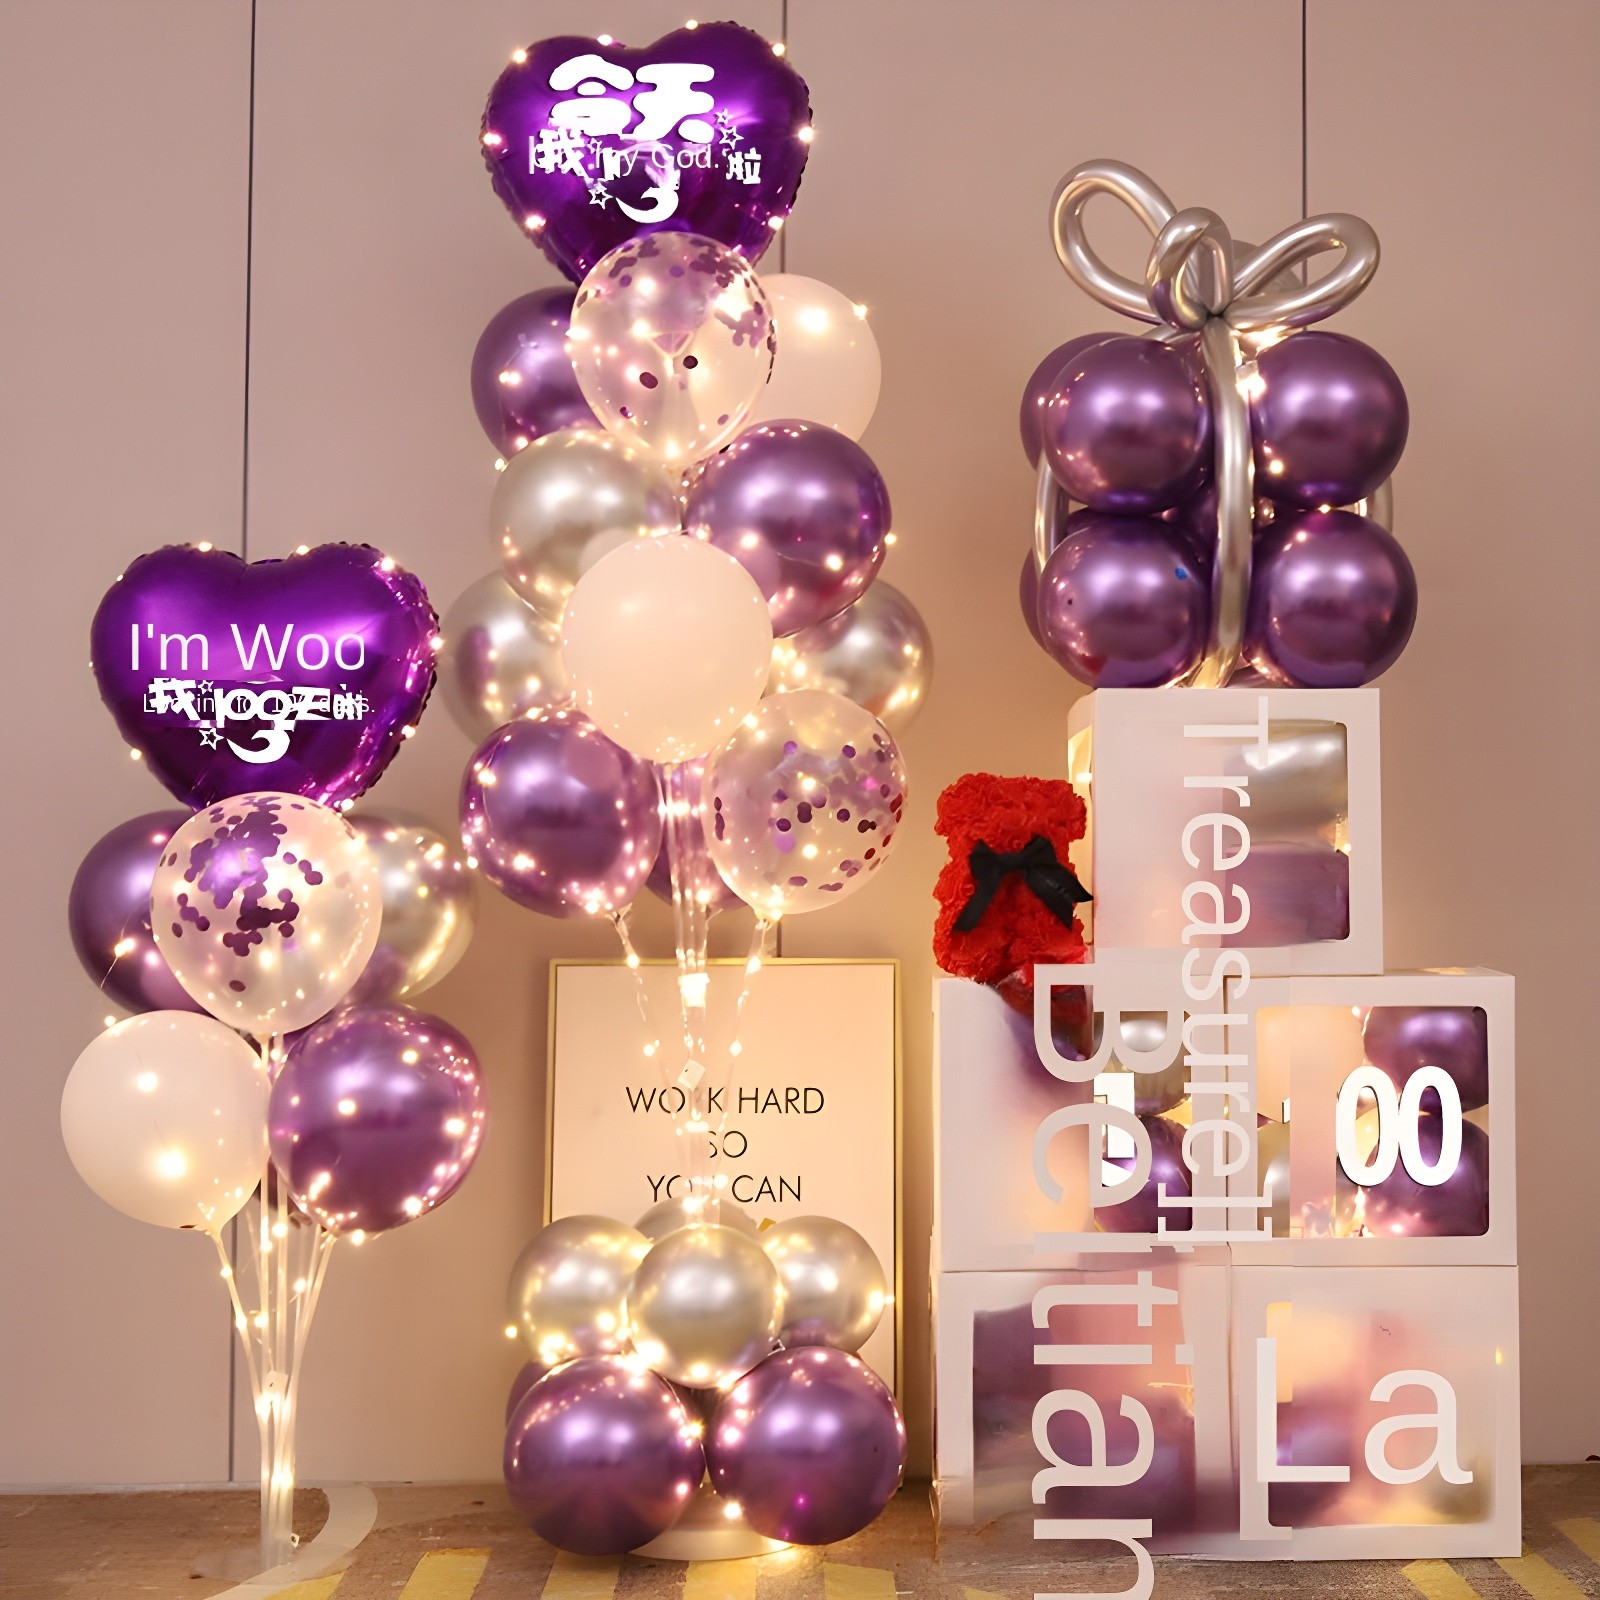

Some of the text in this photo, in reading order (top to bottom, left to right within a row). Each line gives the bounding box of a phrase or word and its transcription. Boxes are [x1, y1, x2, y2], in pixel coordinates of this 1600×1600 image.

[625, 1086, 825, 1114] WOK HARD
[646, 1174, 802, 1203] YO CAN
